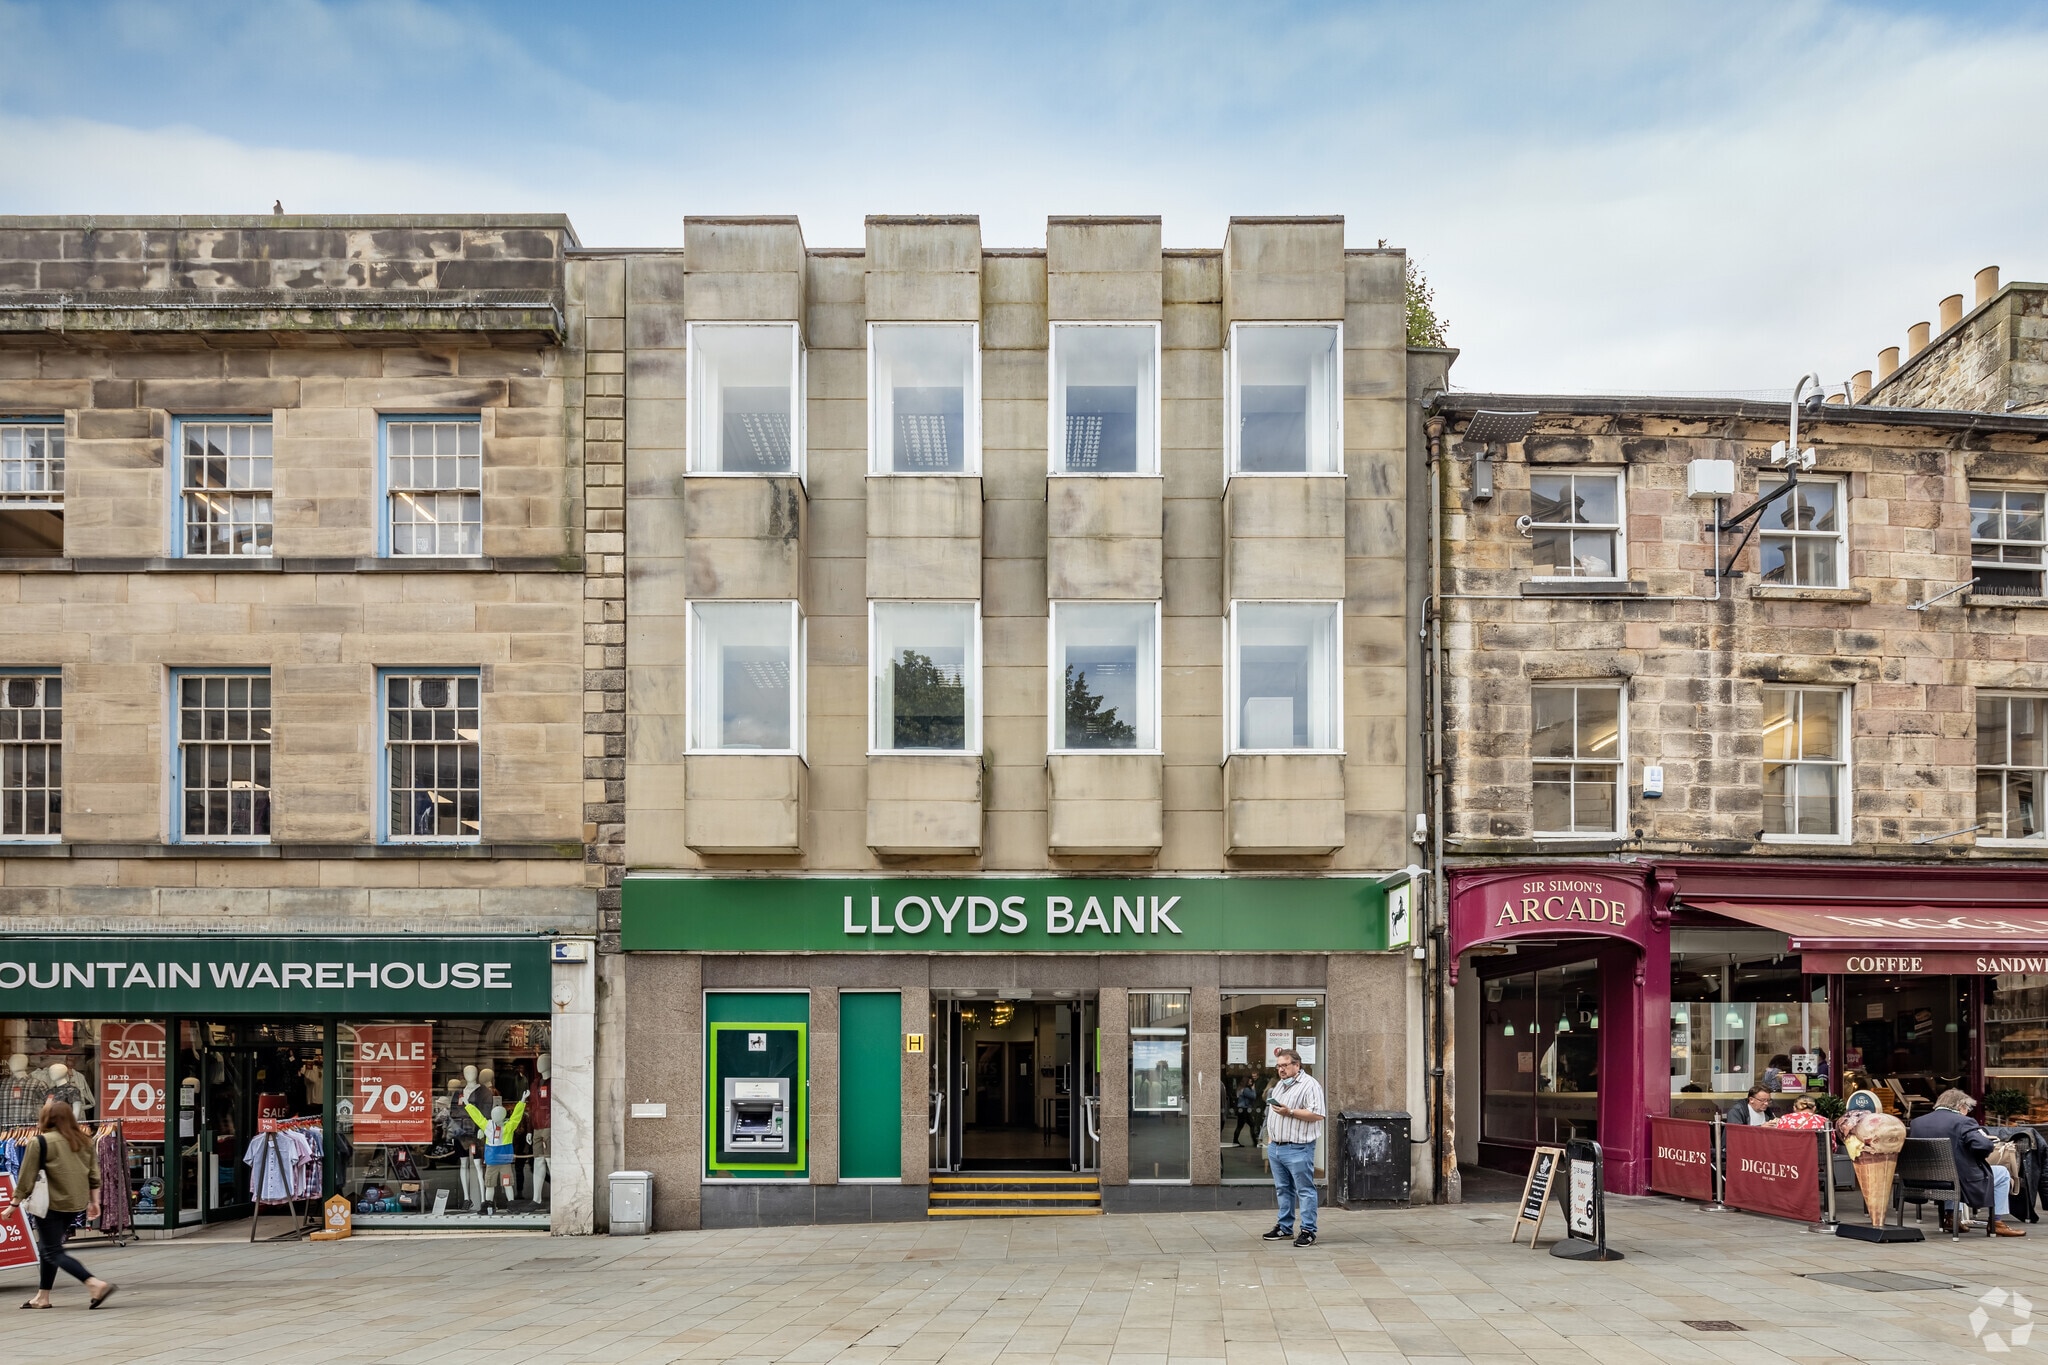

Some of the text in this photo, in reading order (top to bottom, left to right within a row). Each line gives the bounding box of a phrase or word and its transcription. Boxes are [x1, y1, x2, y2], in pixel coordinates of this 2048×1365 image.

[1523, 880, 1602, 894] SIR SIMON'S
[844, 896, 1182, 934] LLOYDS BANK
[1495, 896, 1627, 927] ARCADE
[1846, 956, 2048, 972] COFFEE SANDWI
[208, 962, 512, 989] WAREHOUSE
[361, 1042, 425, 1060] SALE
[909, 1036, 921, 1050] H
[361, 1084, 425, 1113] 70%
[1658, 1146, 1707, 1165] DIGGLE'S
[1741, 1158, 1799, 1179] DIGGLE'S
